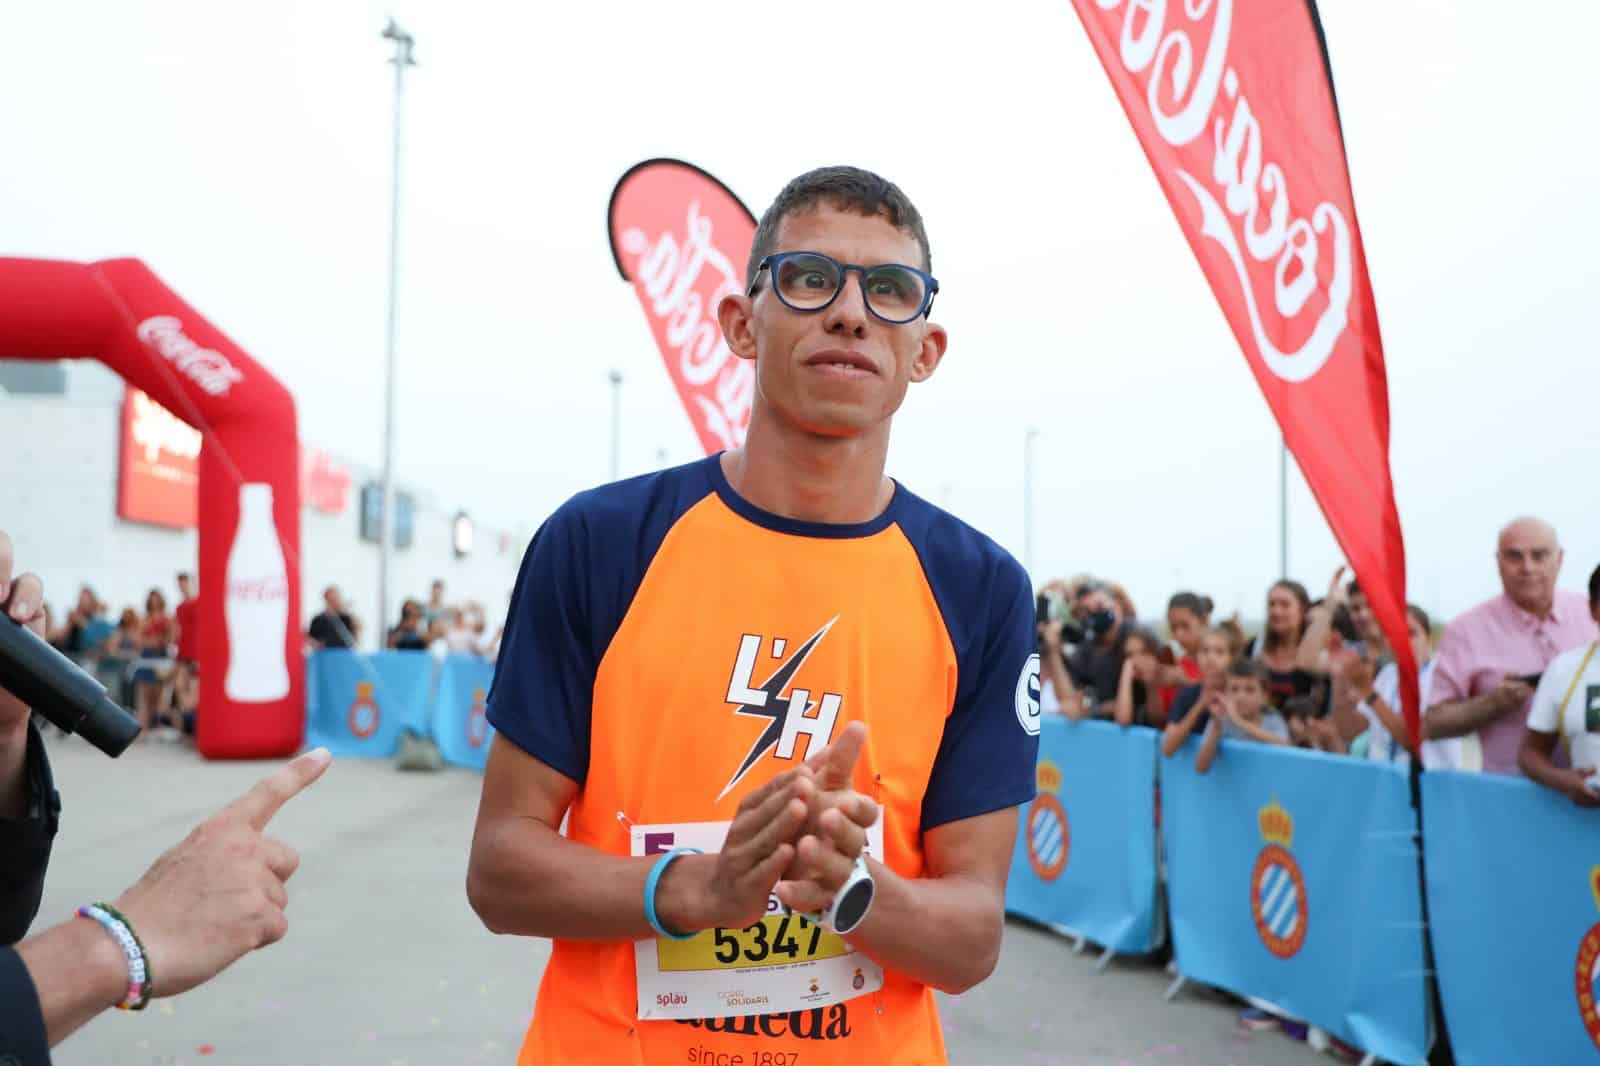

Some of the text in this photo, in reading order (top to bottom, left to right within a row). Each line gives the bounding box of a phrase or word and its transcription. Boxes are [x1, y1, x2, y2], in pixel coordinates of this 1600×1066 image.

[714, 915, 823, 964] 5347
[656, 992, 688, 1007] splau
[687, 1045, 799, 1066] since 1897
